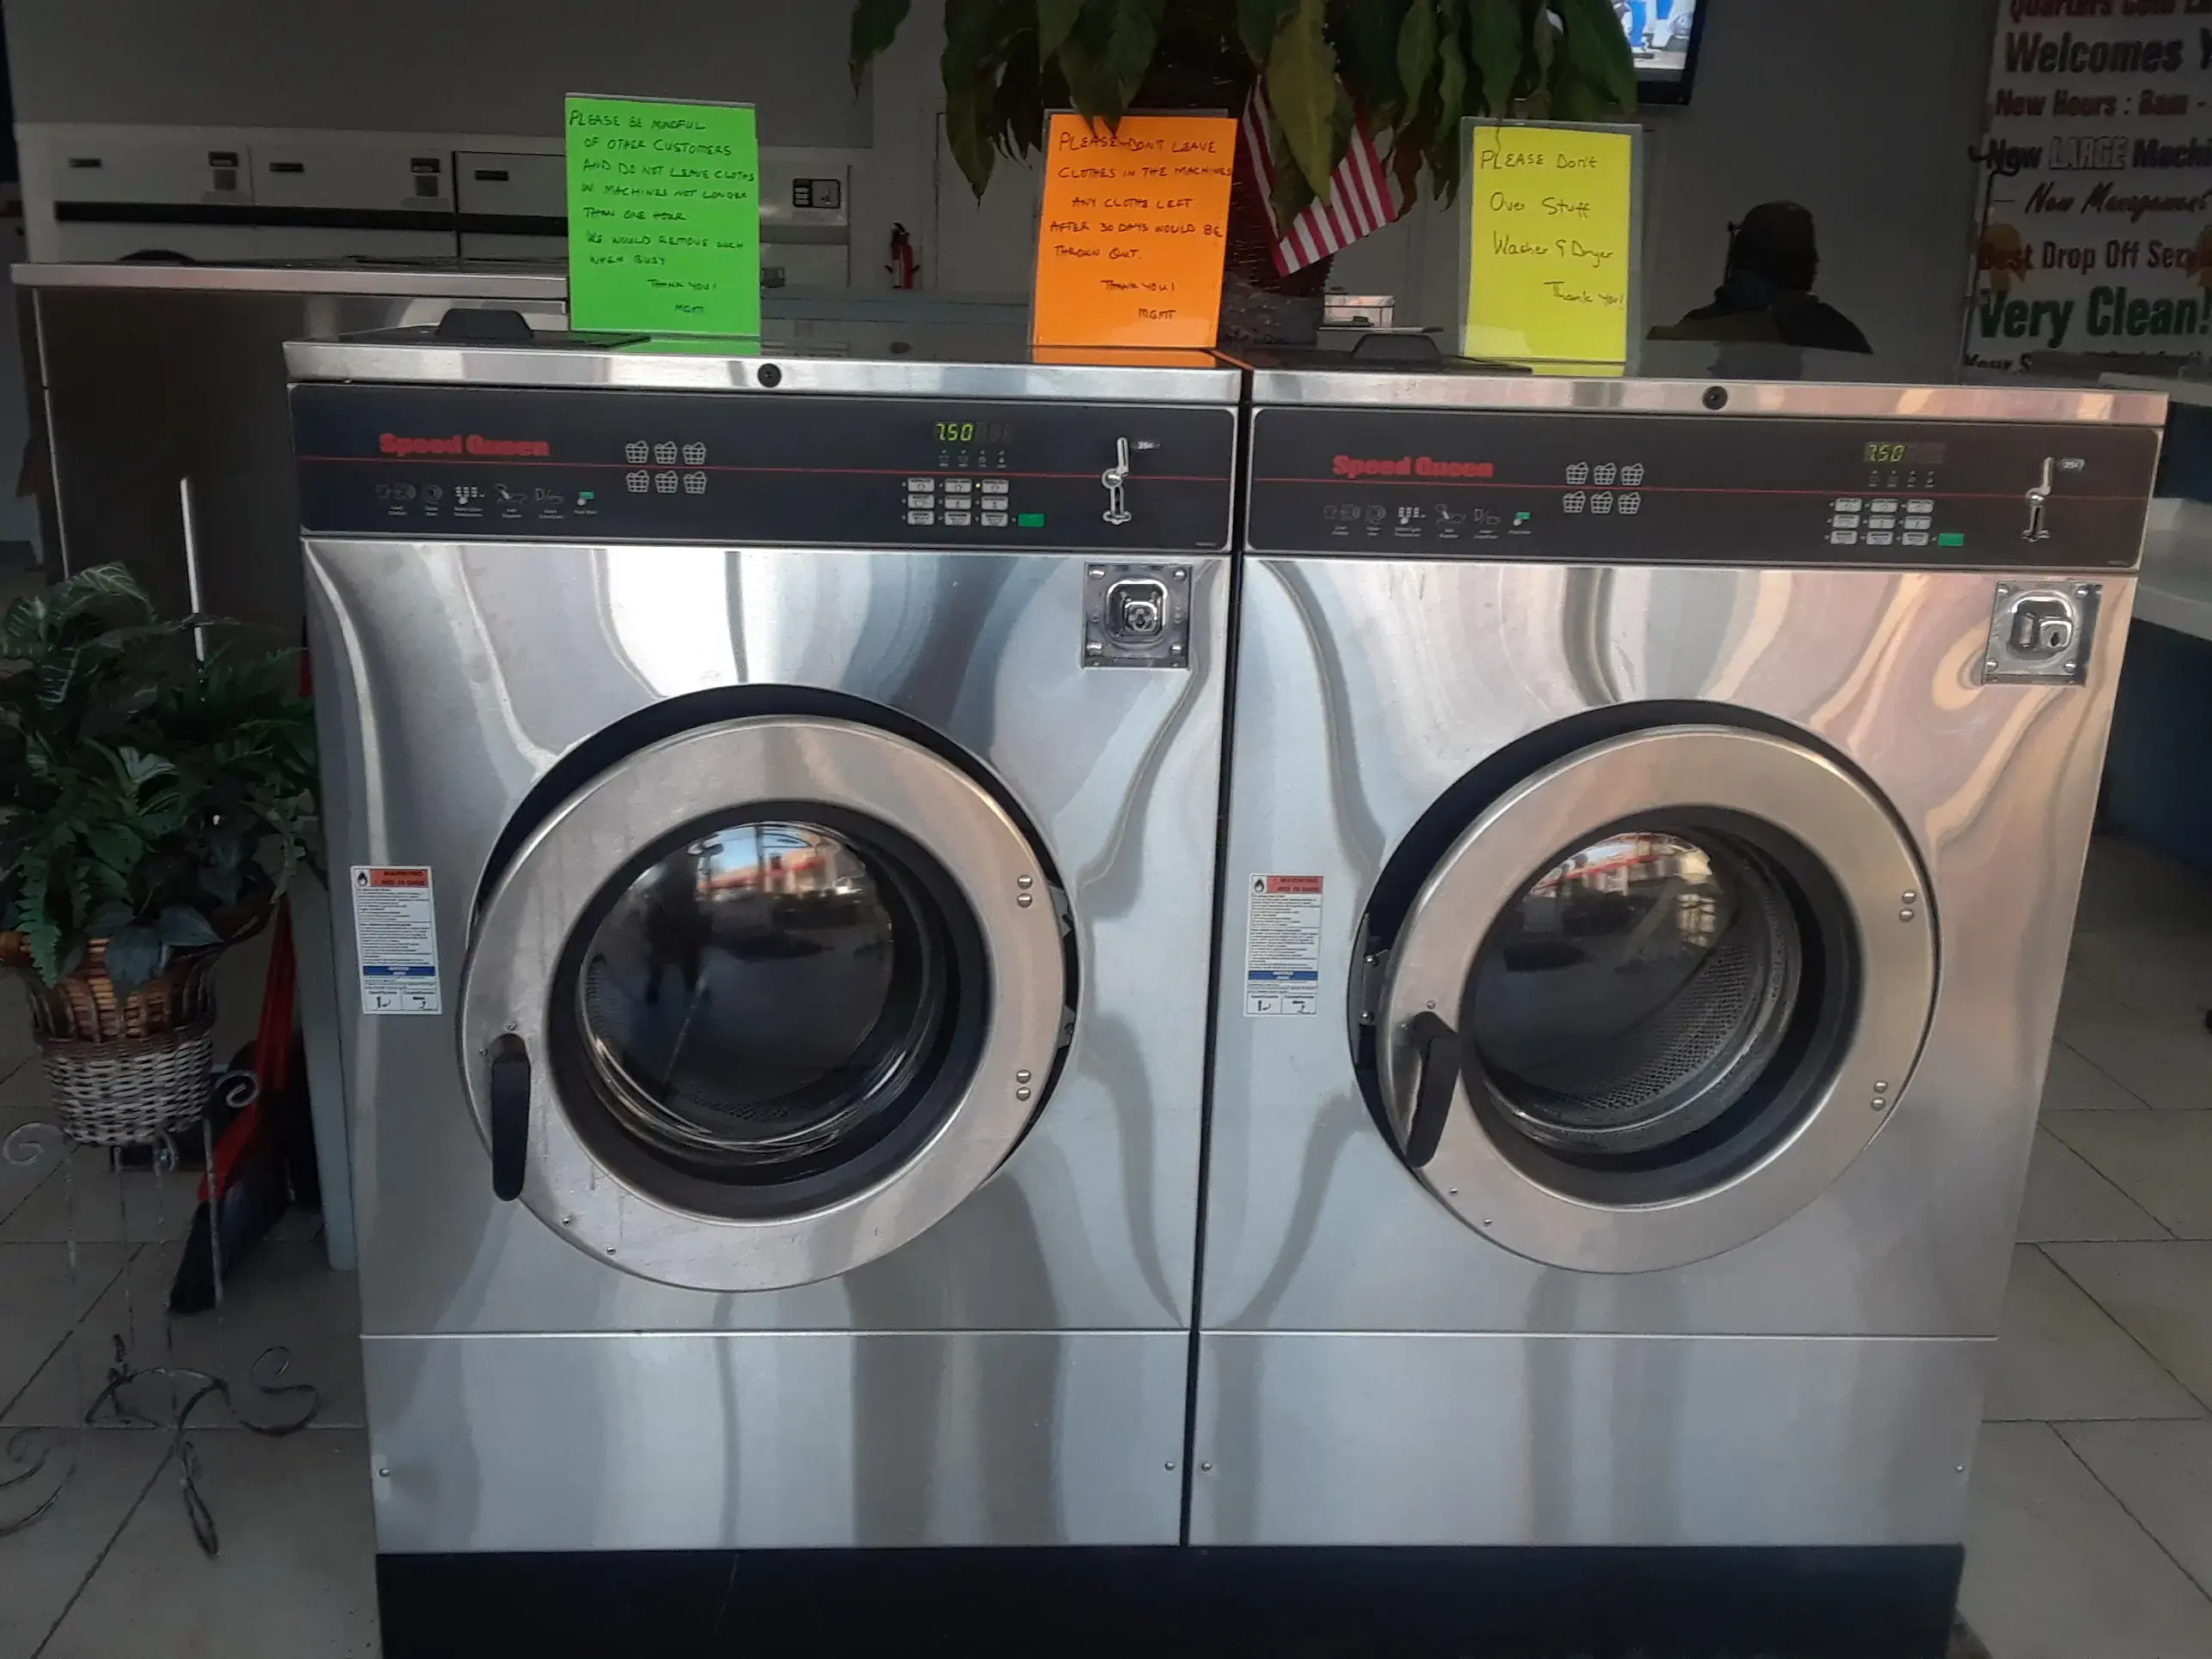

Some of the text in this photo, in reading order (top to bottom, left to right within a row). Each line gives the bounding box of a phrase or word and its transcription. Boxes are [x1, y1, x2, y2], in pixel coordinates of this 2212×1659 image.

[2005, 30, 2185, 74] Welcomes
[1996, 88, 2047, 116] New
[2052, 88, 2118, 117] Hours
[569, 109, 621, 127] PLEASE
[629, 115, 643, 129] BE
[583, 136, 732, 157] OF OTHER CUSTOMERS
[1059, 131, 1120, 152] PLEASE
[1171, 140, 1217, 154] LEAVE
[1986, 137, 2043, 170] New
[2048, 135, 2130, 170] LARGE
[583, 158, 611, 172] AND
[618, 161, 635, 176] DO
[641, 165, 665, 176] NOT
[669, 167, 710, 179] LEAVE
[1480, 149, 1547, 170] PLEASE
[1057, 165, 1232, 179] CLOTHES IN THE MACHINES
[604, 184, 670, 198] MACHINES
[673, 189, 698, 198] NOT
[702, 191, 749, 200] LONGER
[582, 206, 616, 219] THAN
[623, 210, 647, 221] ONE
[1071, 196, 1097, 208] ANY
[1156, 198, 1194, 210] LEFT
[1490, 191, 1591, 221] Over Stuff
[1048, 219, 1224, 238] AFTER 30 DAYS WOULD BE
[611, 235, 652, 246] WOULD
[658, 235, 708, 248] REMOVE
[1054, 244, 1102, 258] THROWN
[1492, 229, 1549, 256] Washer
[1571, 240, 1614, 269] Dryer
[590, 254, 666, 266] WHEN BUSY
[2041, 240, 2096, 276] Drop
[2106, 239, 2141, 269] Off
[646, 278, 684, 289] THANK
[1099, 279, 1139, 292] THANK
[1543, 280, 1626, 311] Thank You!
[1978, 285, 2212, 349] Very Clean!
[379, 432, 550, 458] Speed Queen
[1333, 454, 1494, 480] Speed Queen
